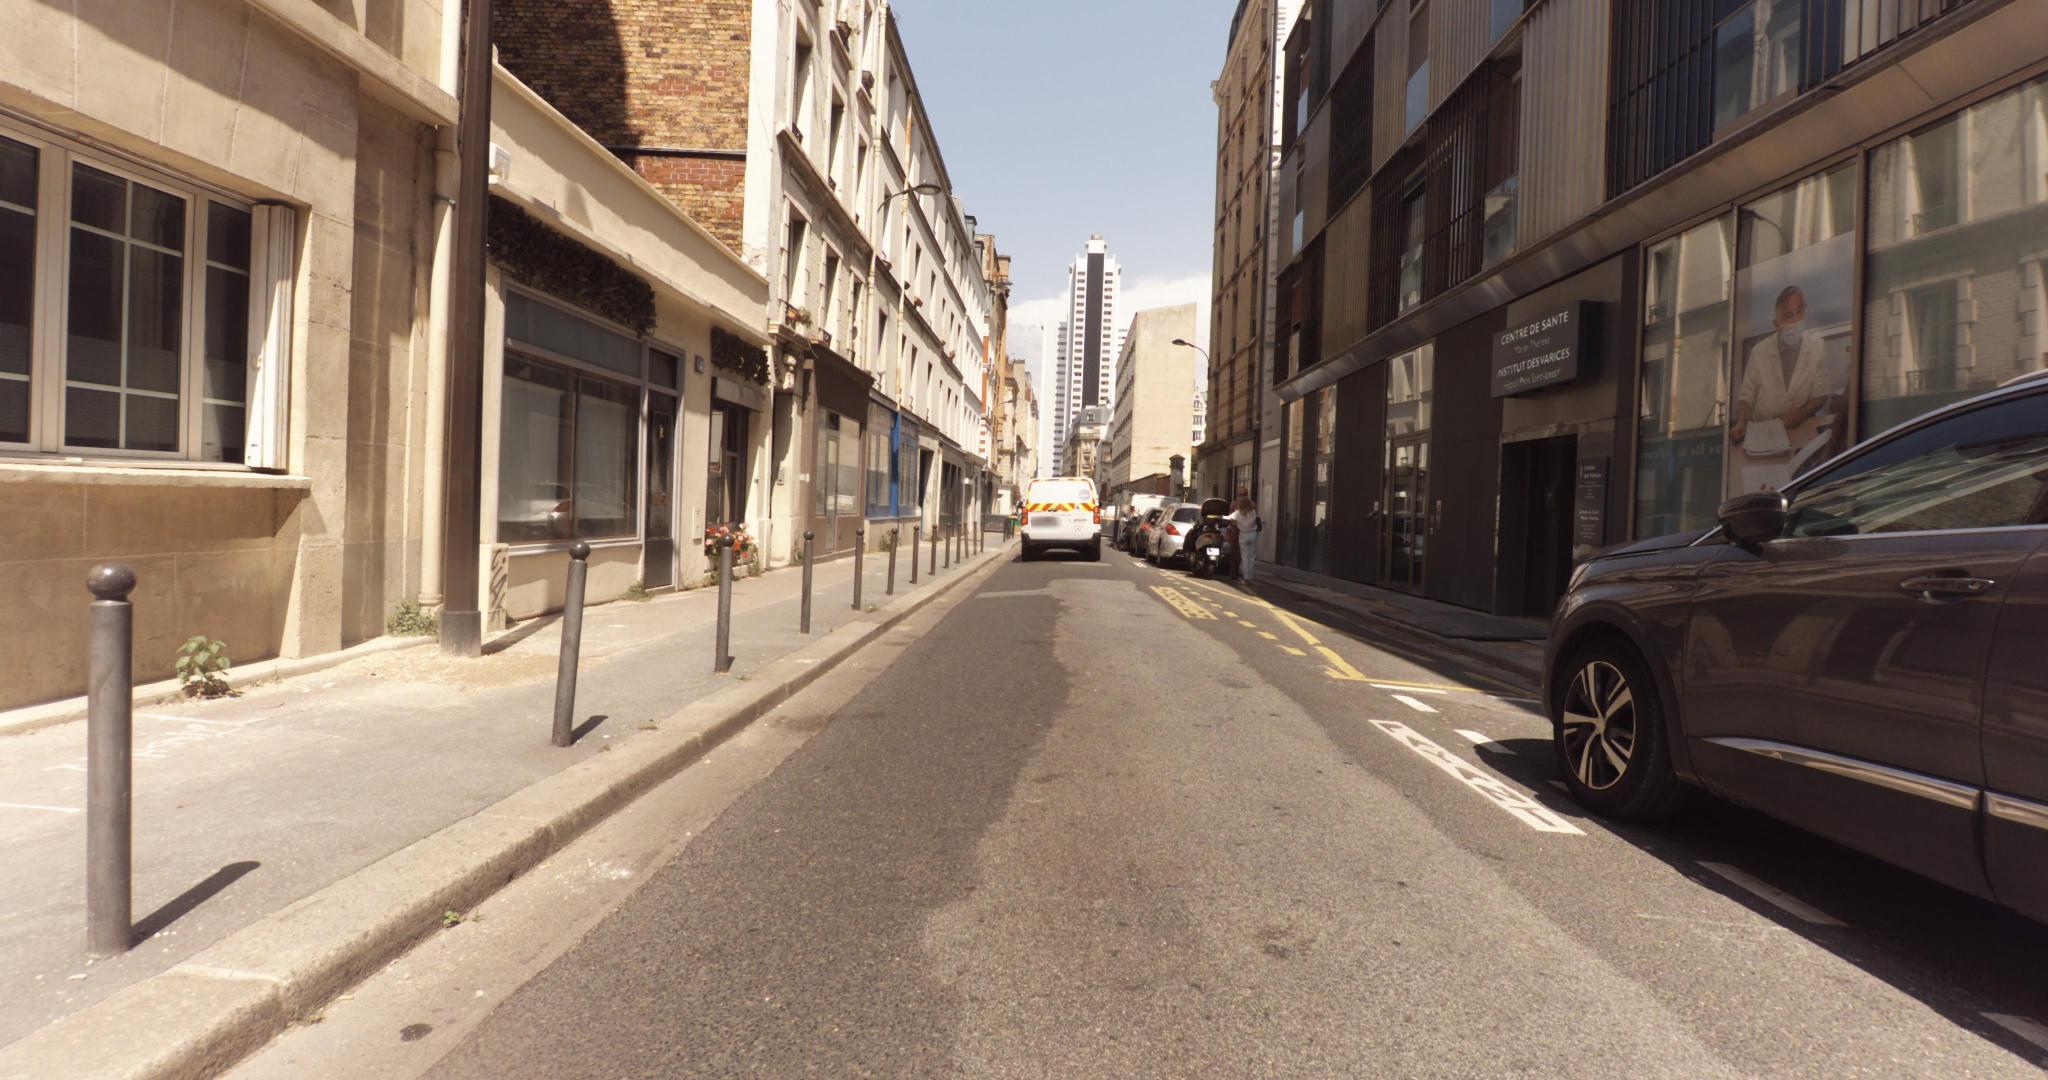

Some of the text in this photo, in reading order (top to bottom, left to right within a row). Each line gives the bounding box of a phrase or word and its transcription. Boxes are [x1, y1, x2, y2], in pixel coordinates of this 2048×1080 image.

[1501, 326, 1528, 346] CENTRE
[1529, 322, 1541, 335] DE
[1497, 361, 1526, 378] INSTITUT
